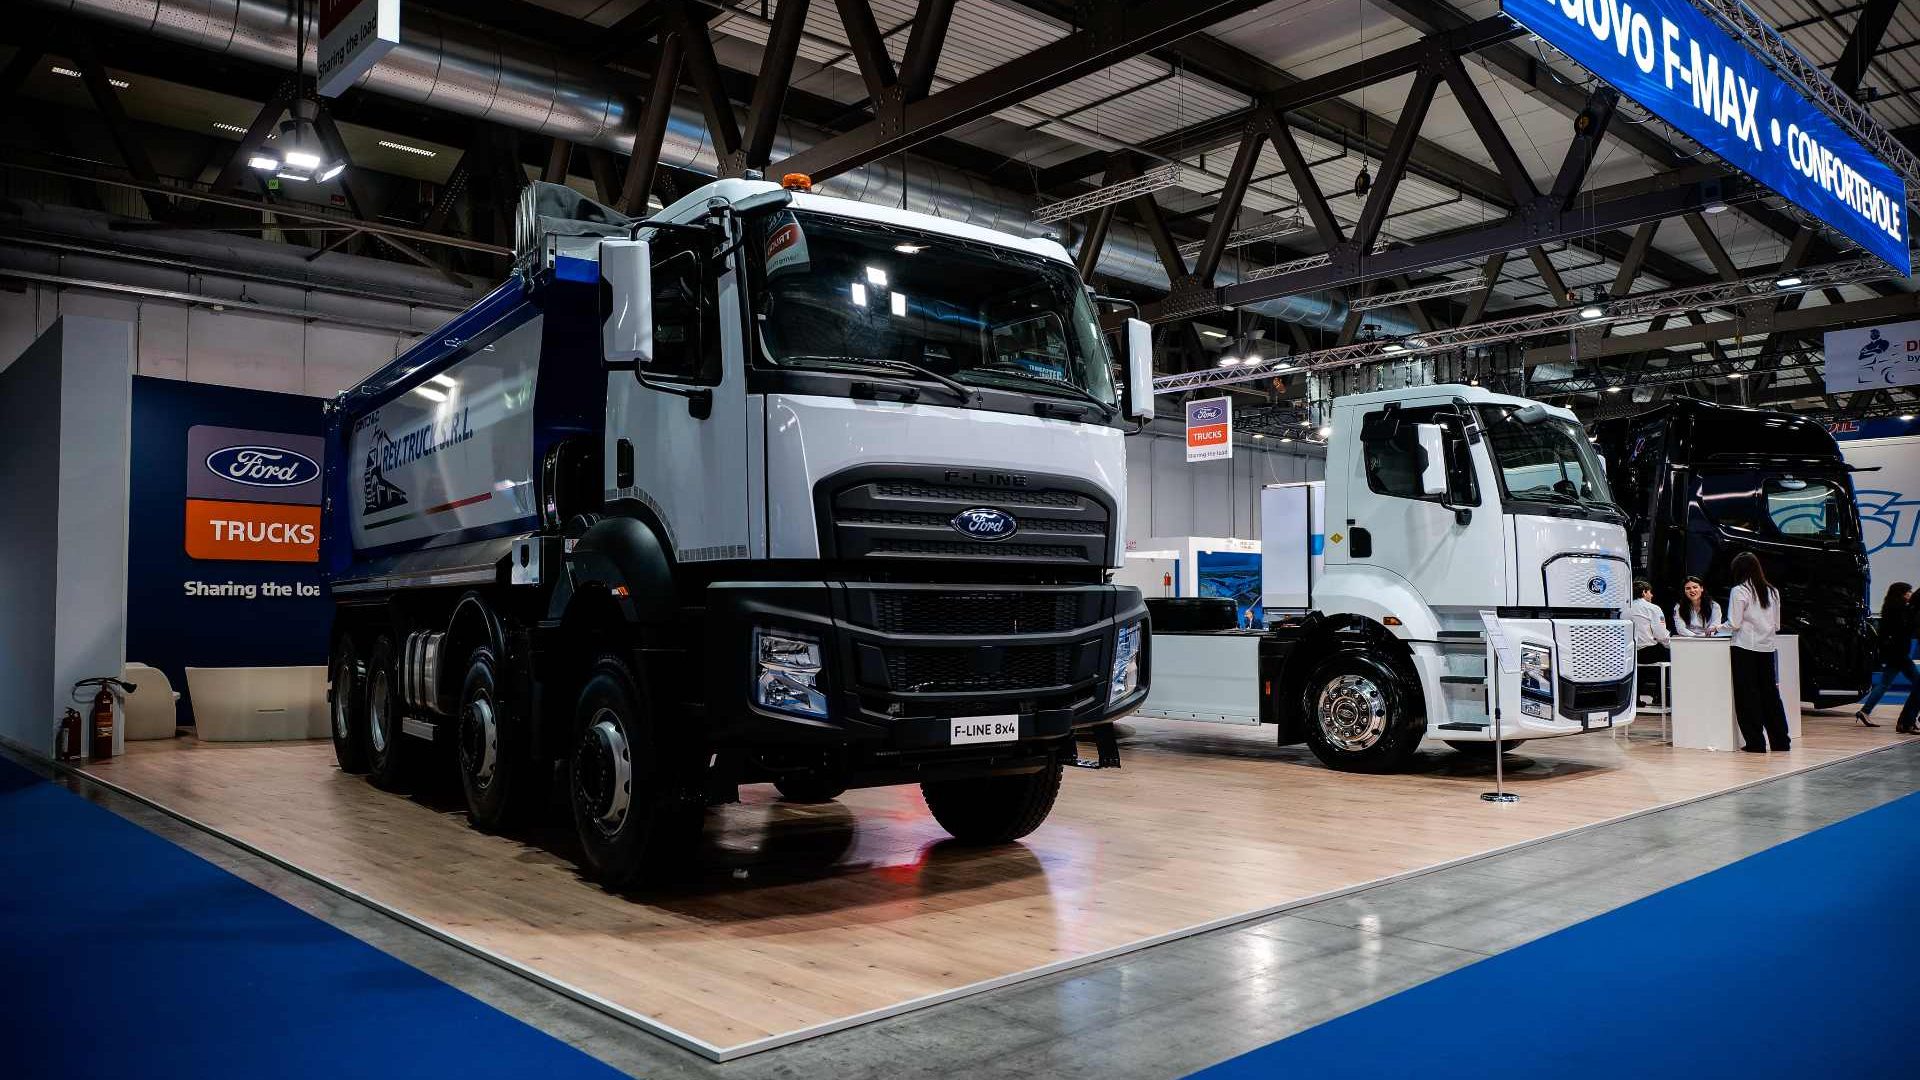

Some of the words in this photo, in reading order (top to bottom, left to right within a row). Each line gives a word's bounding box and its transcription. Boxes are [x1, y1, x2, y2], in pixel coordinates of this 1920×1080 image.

[319, 46, 345, 81] Sharing
[346, 34, 359, 54] the
[361, 12, 377, 41] load
[1546, 0, 1655, 73] uovo
[1662, 16, 1763, 152] F-MAX
[1787, 123, 1902, 241] CONFORTEVOLE
[1193, 430, 1222, 441] TRUCKS
[229, 450, 299, 481] Ford
[944, 468, 1027, 486] F-LINE
[210, 519, 315, 544] TRUCKS
[968, 512, 1005, 532] Ford
[184, 581, 257, 599] Sharing
[261, 582, 292, 597] the
[297, 582, 320, 597] loa
[954, 723, 992, 737] F-LINE
[995, 722, 1015, 735] 8x4
